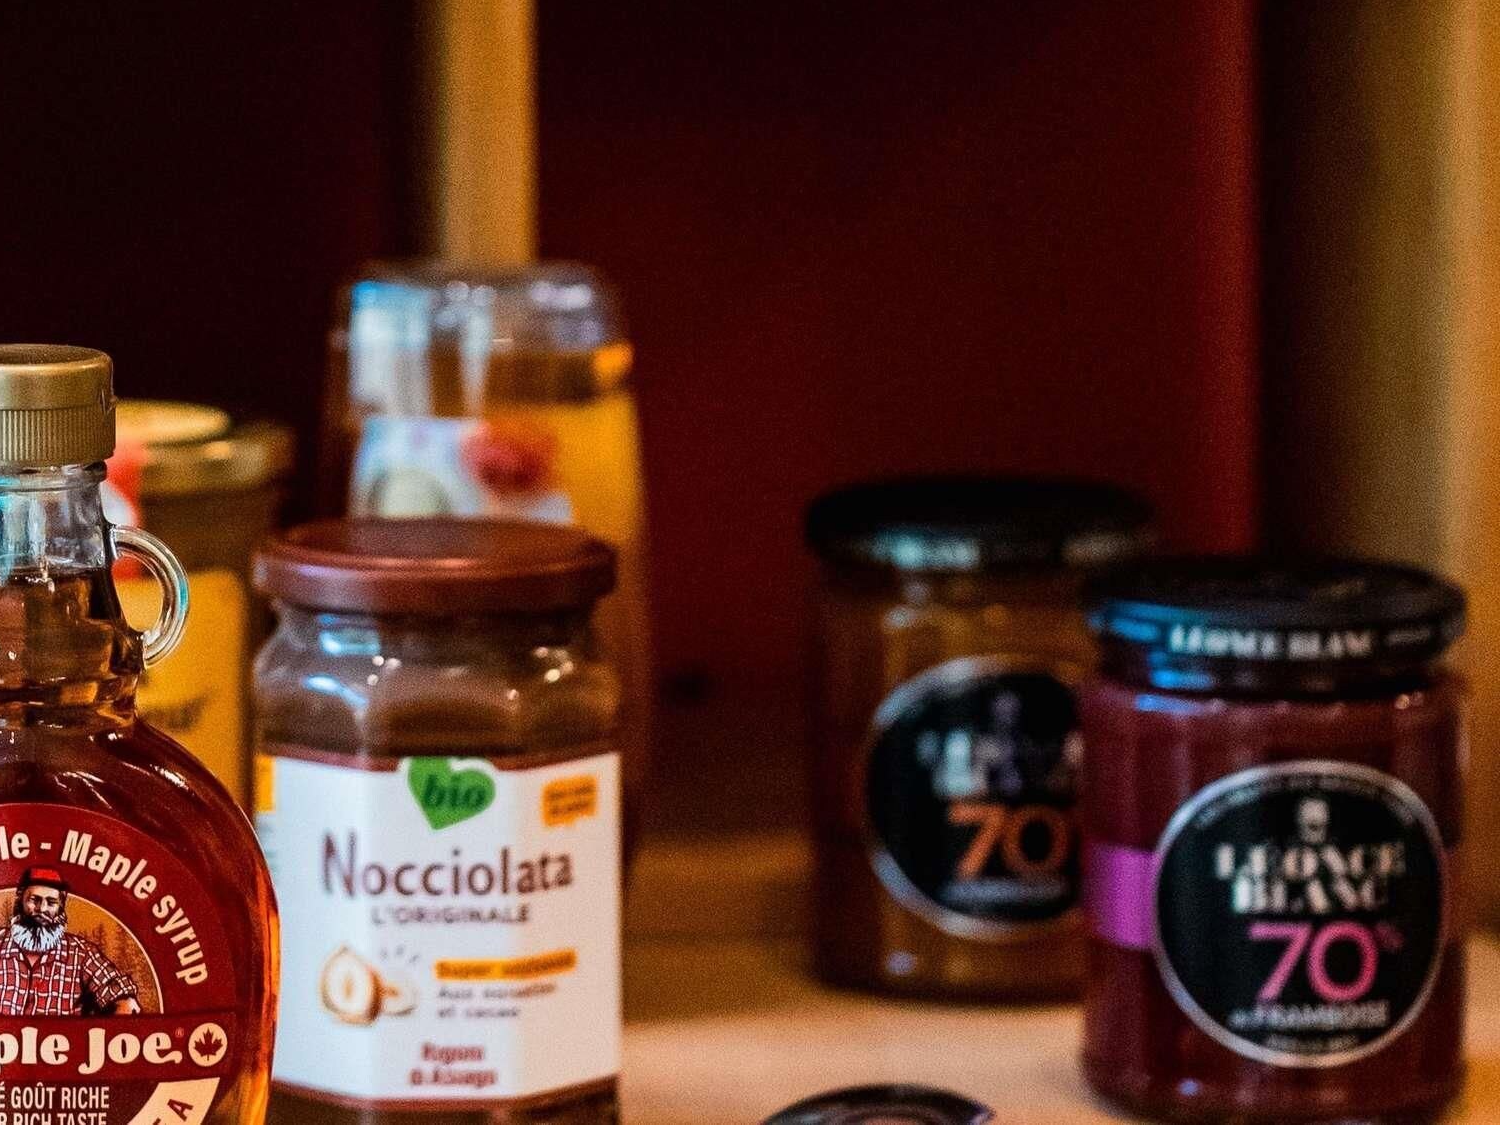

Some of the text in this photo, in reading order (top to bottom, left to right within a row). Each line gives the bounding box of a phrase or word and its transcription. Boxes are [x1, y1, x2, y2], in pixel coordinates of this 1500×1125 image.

[423, 773, 487, 808] bio
[321, 828, 573, 898] Nocciolata
[59, 828, 158, 900] Maple
[151, 893, 209, 986] syrup
[371, 902, 530, 926] L'ORIGINALE
[77, 1027, 184, 1075] Joe
[10, 1081, 56, 1110] GOÛT
[60, 1085, 110, 1110] RICHE
